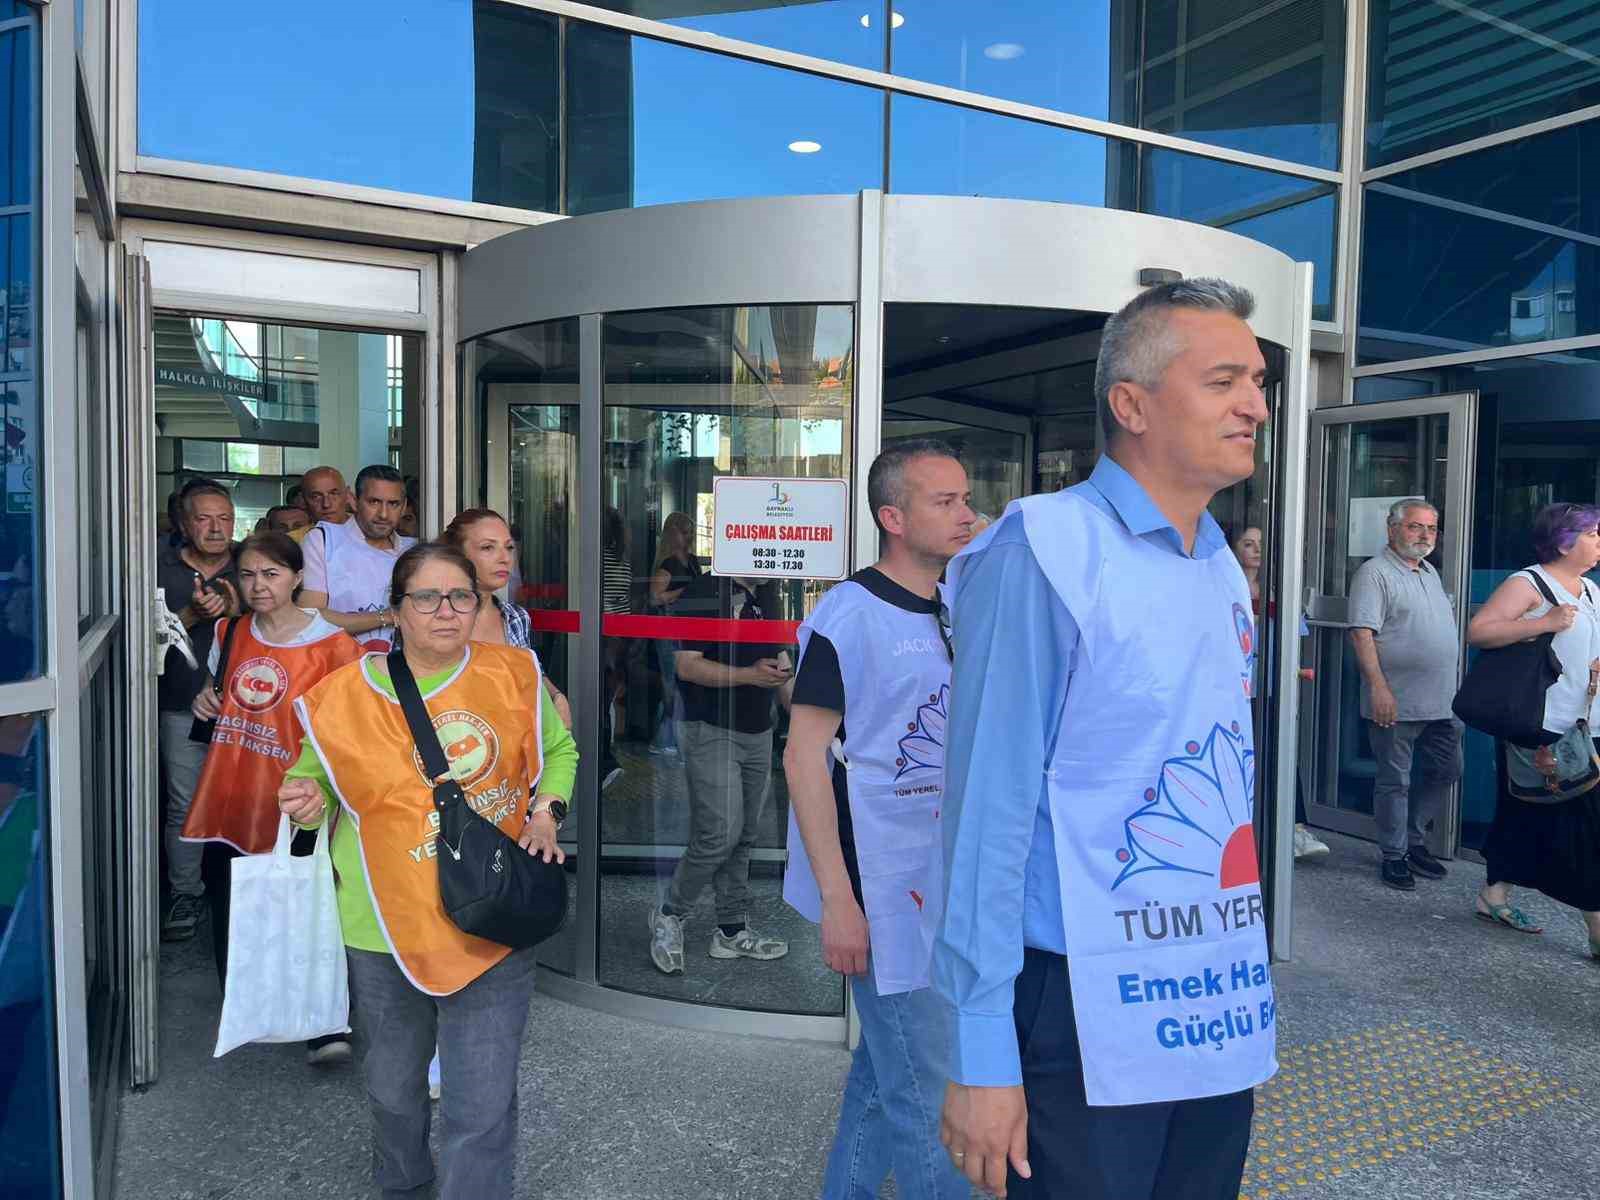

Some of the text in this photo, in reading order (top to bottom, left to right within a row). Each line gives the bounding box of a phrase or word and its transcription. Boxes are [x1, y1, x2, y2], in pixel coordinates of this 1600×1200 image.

[159, 369, 206, 386] HALKLA
[725, 523, 833, 541] ÇALIŞMA SAATLERİ
[752, 547, 776, 557] 08:30
[783, 549, 805, 559] 12.30
[753, 559, 776, 569] 13:30
[782, 561, 803, 570] 17.30
[1114, 901, 1203, 942] TÜM
[1118, 960, 1270, 1004] Emek Ha
[1156, 1006, 1253, 1050] Güçlü
